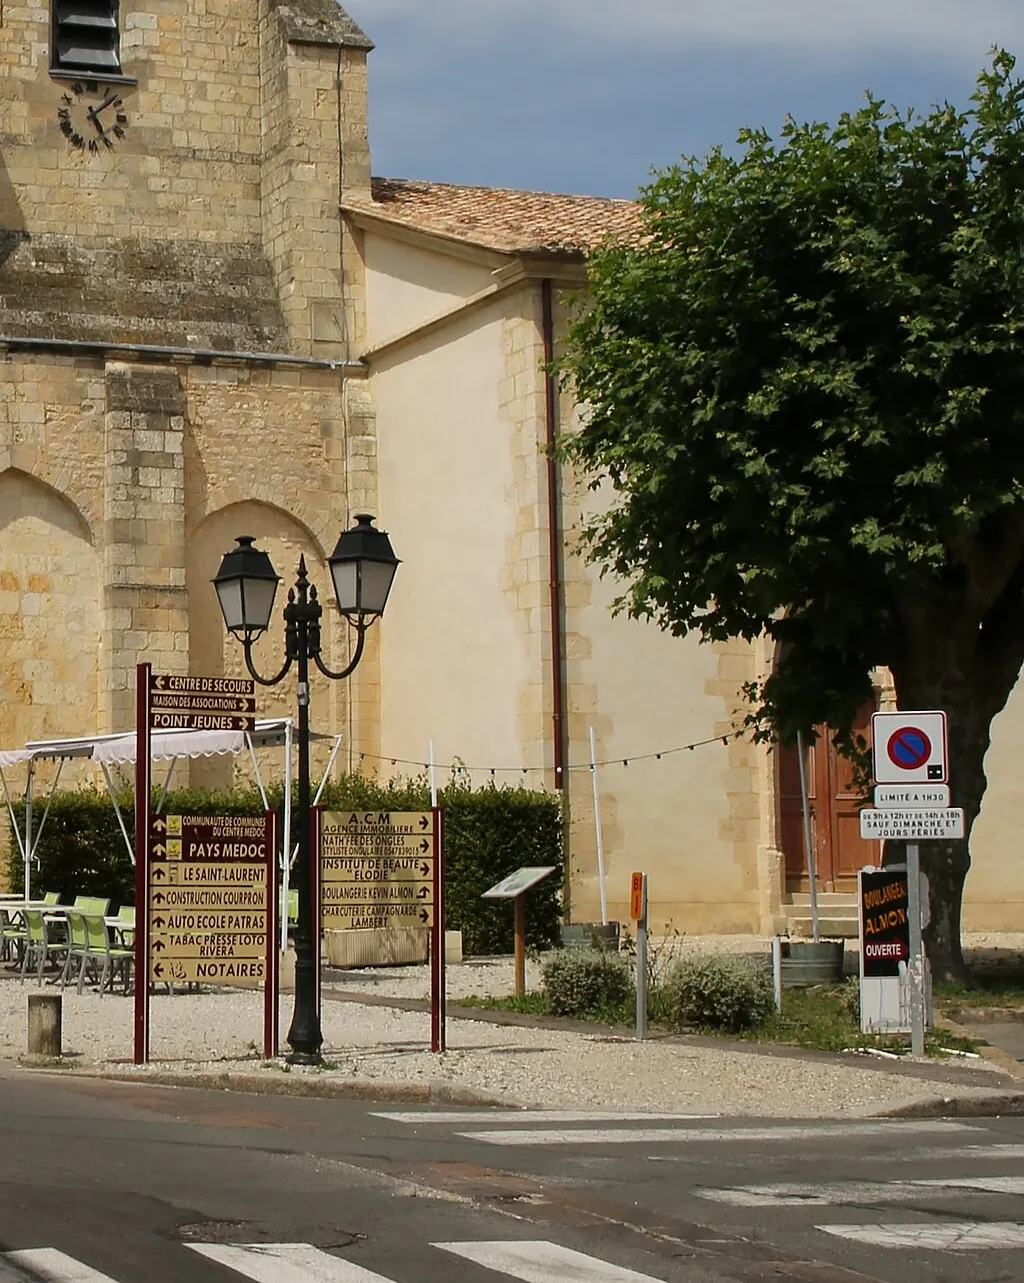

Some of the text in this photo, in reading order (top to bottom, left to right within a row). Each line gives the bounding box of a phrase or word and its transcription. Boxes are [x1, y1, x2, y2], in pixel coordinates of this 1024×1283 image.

[169, 677, 251, 693] CENTRE DE SECOURS
[153, 696, 237, 709] MAISON DES ASSOCIATIONS
[154, 715, 233, 729] POINT JEUNES
[183, 816, 266, 827] COMMUNAUTE DE COMMUNES
[349, 813, 390, 825] A.C.M
[213, 827, 265, 837] DU CENTRE MEDOC
[324, 825, 414, 834] AGENCE IMMOBILIERE
[360, 836, 374, 846] DES
[375, 836, 405, 846] ONGLES
[190, 844, 265, 857] PAYS MEDOC
[323, 847, 348, 856] STYLISTE
[349, 847, 383, 856] ONGULAIRE
[323, 860, 419, 869] INSTITUT DE BEAUTE
[184, 868, 265, 881] LE SAINT-LAURENT
[167, 892, 264, 905] CONSTRUCTION COURPRON
[322, 888, 413, 899] BOULANGERIE KEVIN ALMON
[321, 907, 417, 916] CHARCUTERIE CAMPAGNARDE
[168, 916, 264, 929] AUTO ECOLE PATRAS
[351, 918, 388, 928] LAMBERT
[865, 909, 906, 936] ALMON
[170, 935, 265, 946] TABAC PRESSE LOTO
[200, 946, 234, 956] RIVERA
[866, 944, 901, 956] OUVERTE
[197, 964, 264, 977] NOTAIRES
